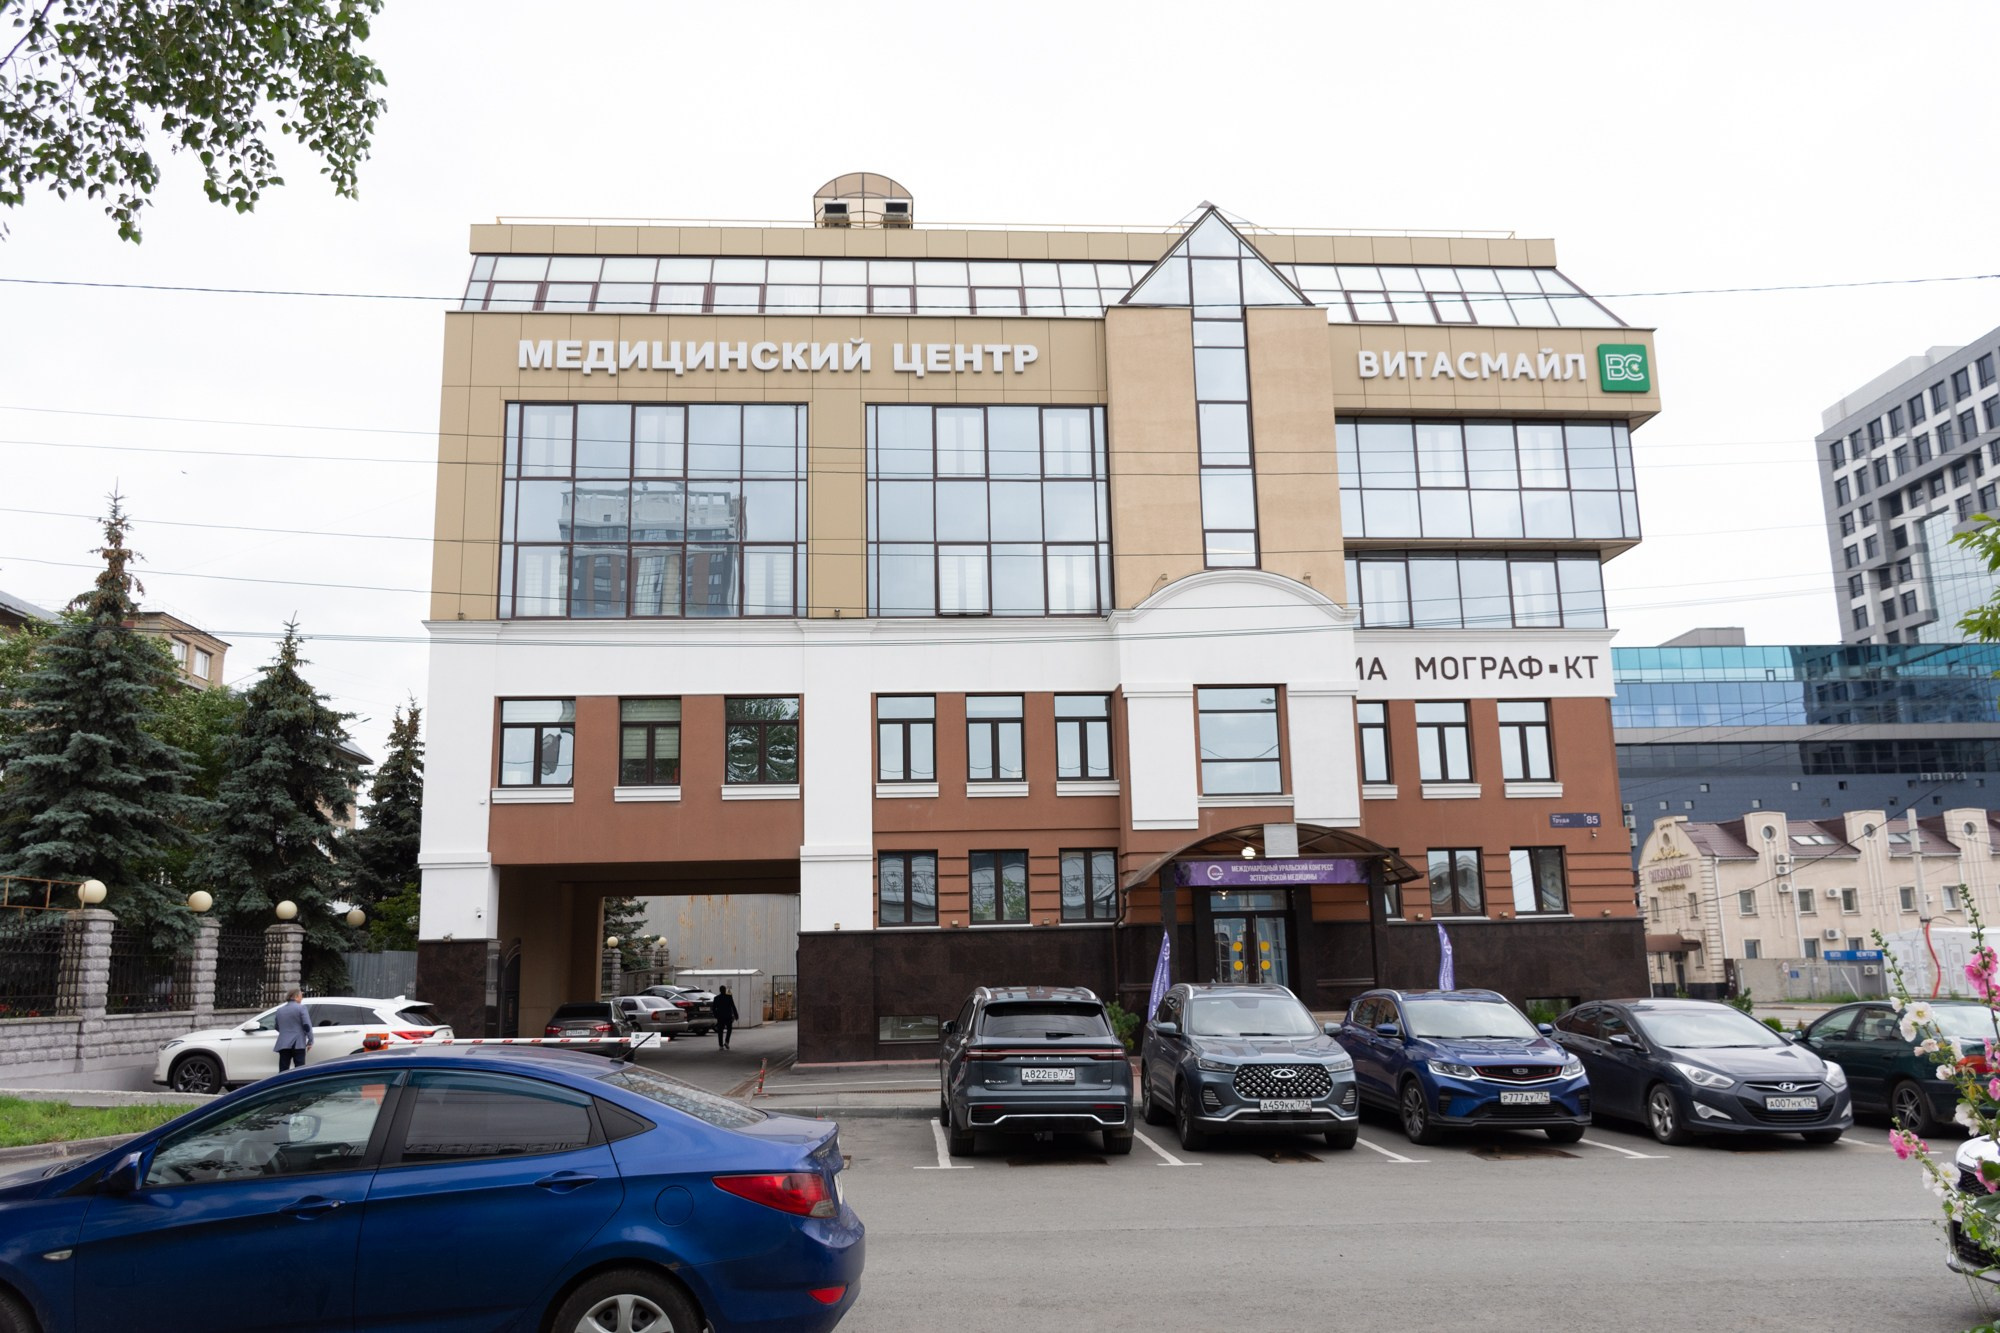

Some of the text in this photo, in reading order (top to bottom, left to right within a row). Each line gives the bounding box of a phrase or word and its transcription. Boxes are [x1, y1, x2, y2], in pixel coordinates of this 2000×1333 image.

[518, 337, 1039, 378] МЕДИЦИНСКИЙ ЦЕНТР
[1358, 348, 1587, 381] ВИТАСМАЙЛ
[1586, 815, 1599, 825] 85
